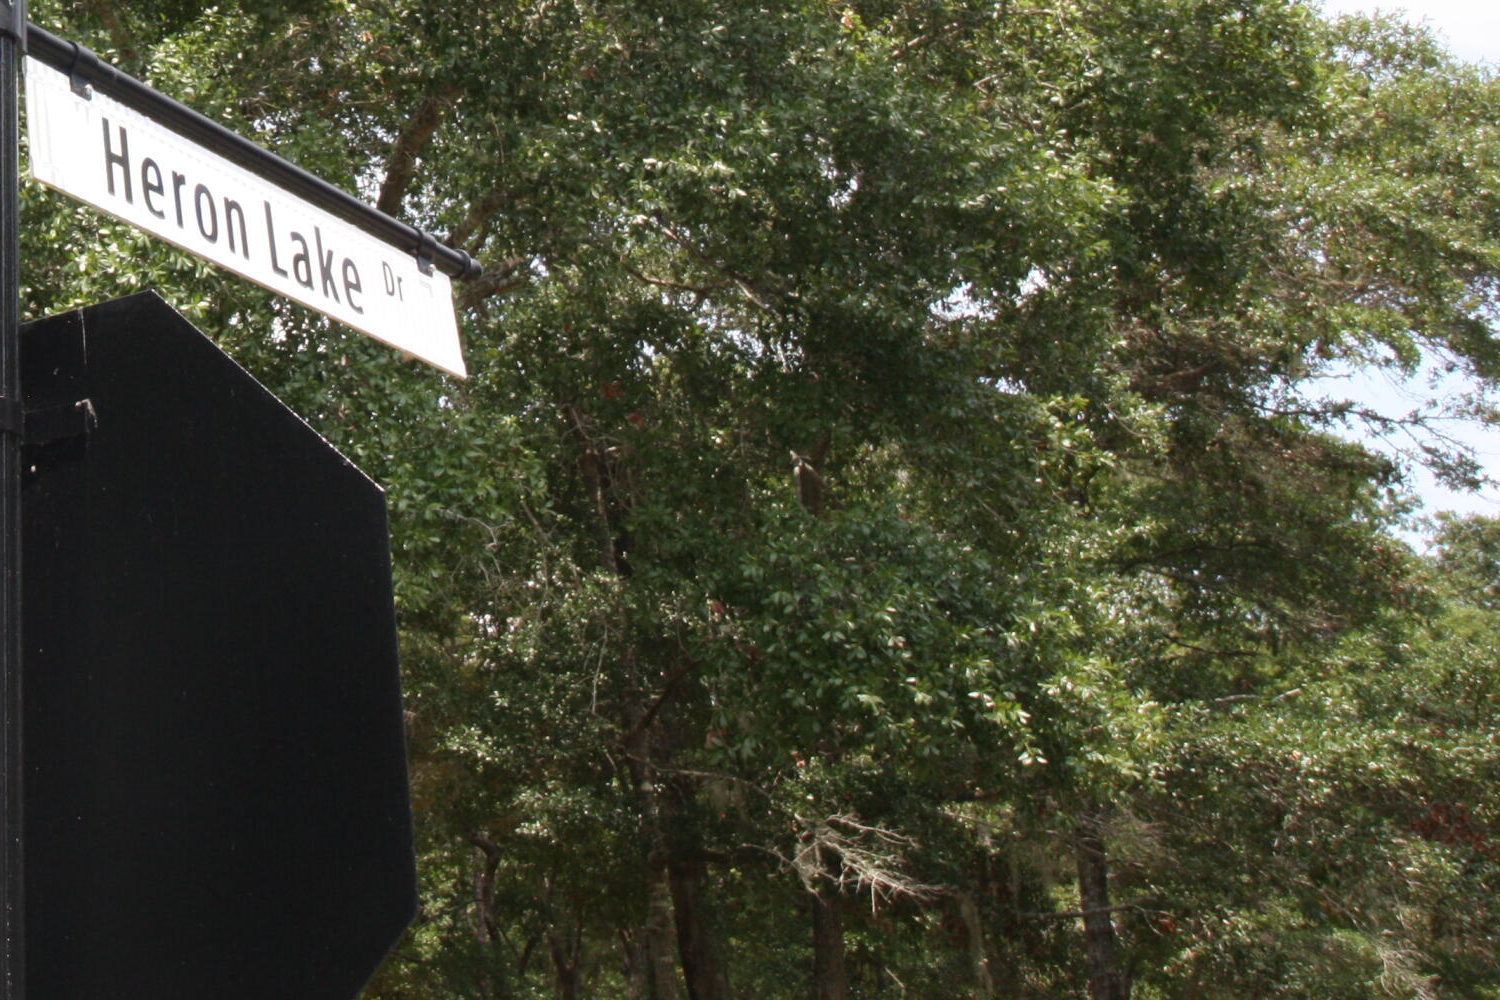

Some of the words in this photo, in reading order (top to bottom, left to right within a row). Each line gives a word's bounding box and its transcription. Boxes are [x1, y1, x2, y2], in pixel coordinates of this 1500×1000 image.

[101, 117, 250, 261] Heron
[264, 200, 364, 315] Lake
[381, 260, 404, 302] Dr
